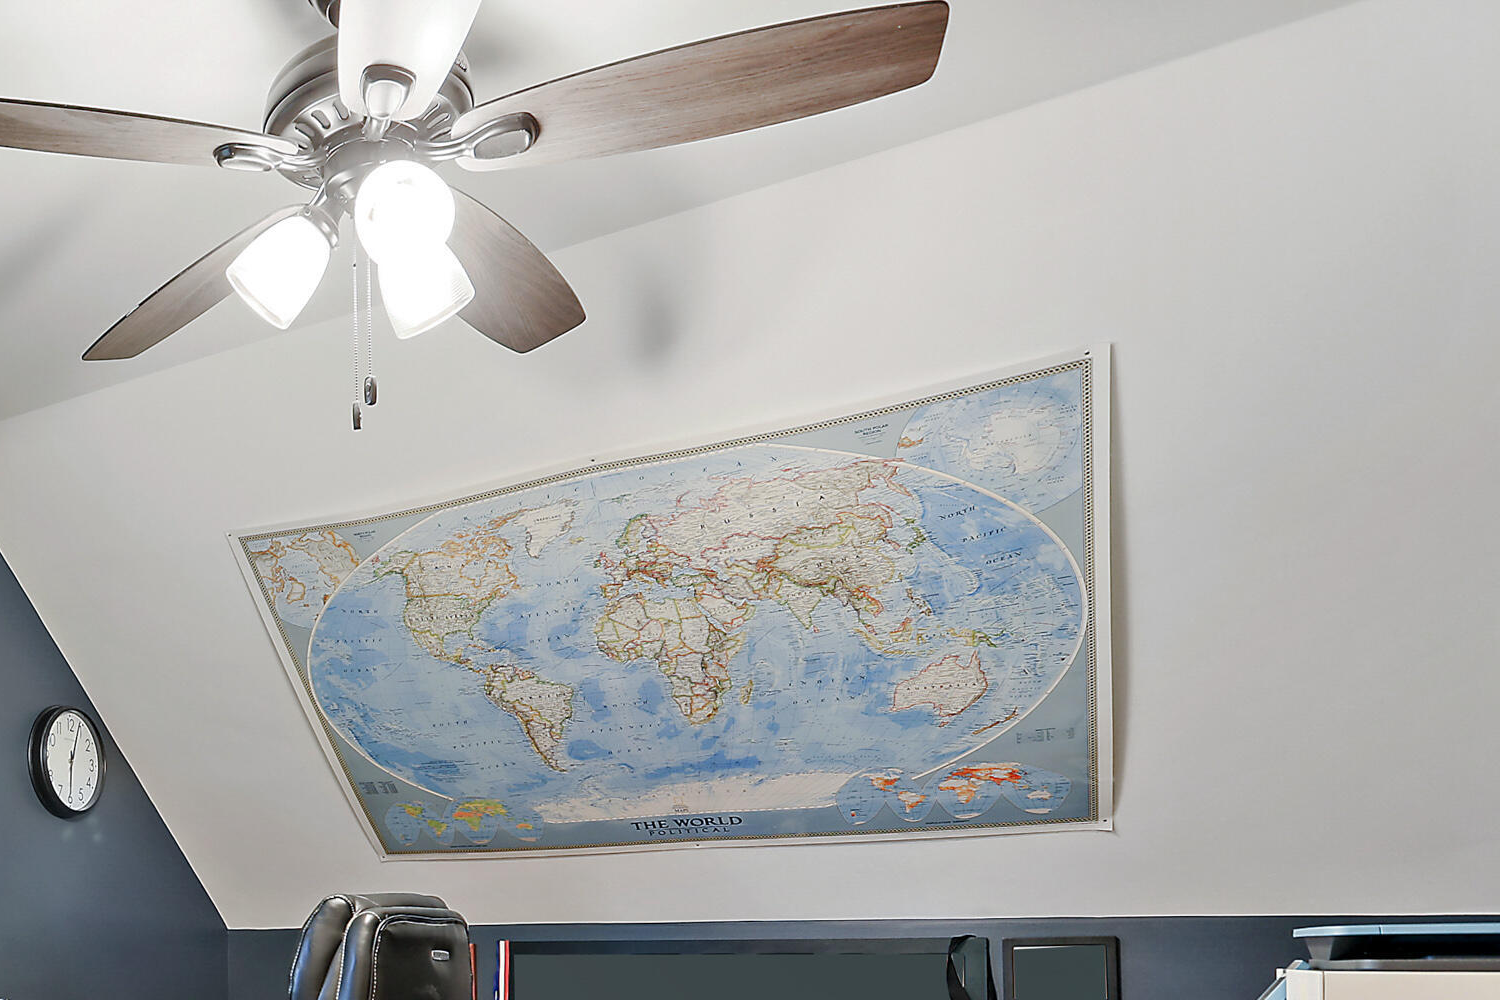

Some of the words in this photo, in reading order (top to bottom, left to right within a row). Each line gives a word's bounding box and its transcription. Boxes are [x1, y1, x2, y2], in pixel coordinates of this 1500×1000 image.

[938, 505, 975, 520] NORTH
[962, 526, 1007, 543] PACIFIC
[985, 551, 1022, 565] OCEAN
[57, 721, 62, 735] 11
[67, 717, 75, 732] 12
[85, 738, 91, 752] 2
[89, 758, 95, 772] 3
[86, 777, 91, 788] 4
[58, 784, 63, 797] 7
[79, 787, 84, 801] 5
[631, 820, 669, 831] THE
[673, 816, 743, 828] WORLD
[649, 826, 731, 837] POLITICAL
